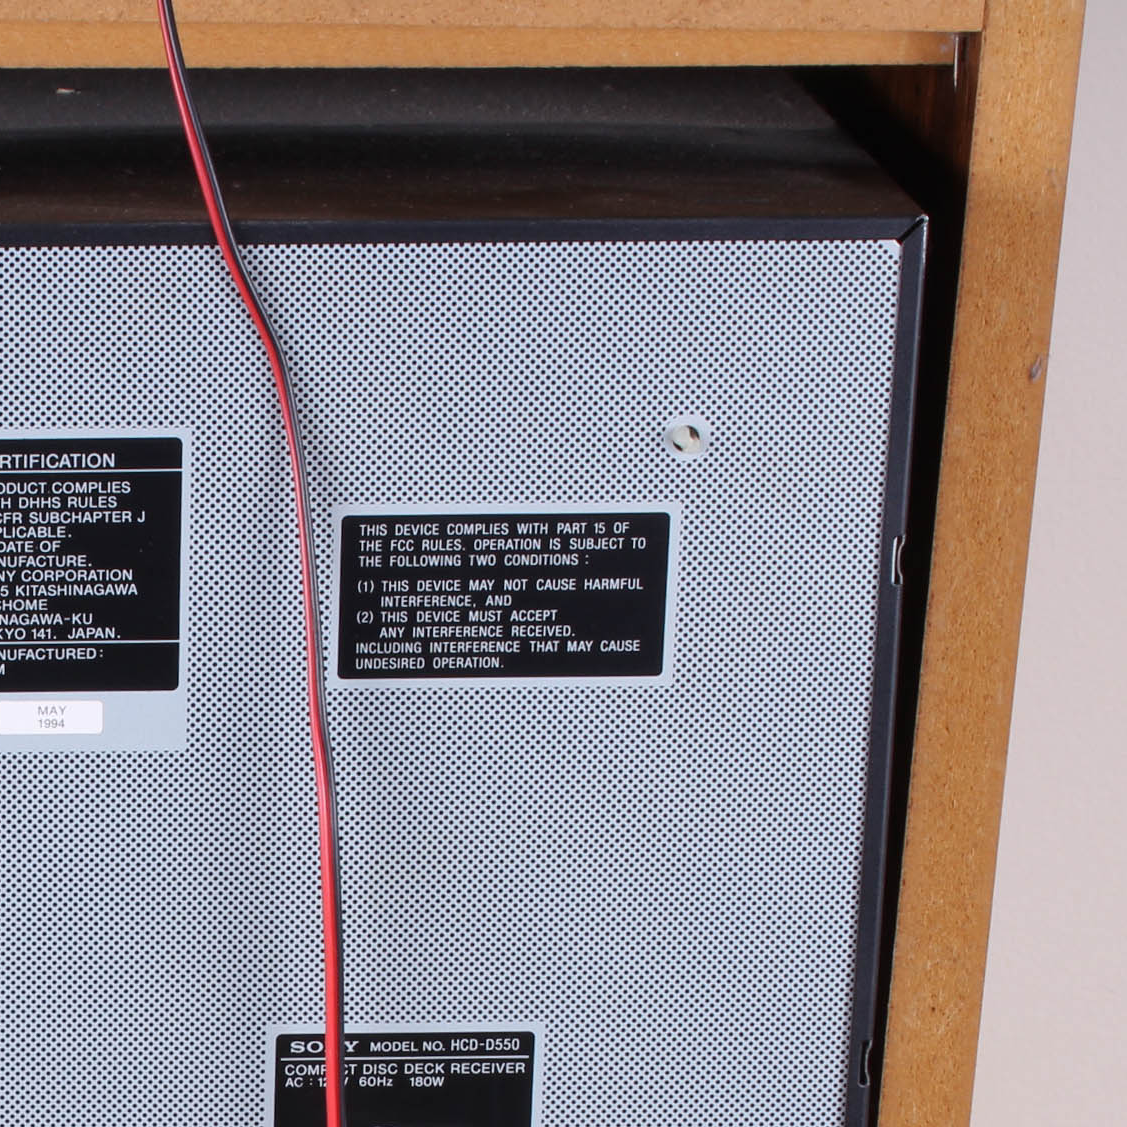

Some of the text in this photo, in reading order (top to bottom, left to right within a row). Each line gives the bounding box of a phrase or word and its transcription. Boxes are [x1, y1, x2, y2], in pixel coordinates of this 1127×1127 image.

[51, 481, 131, 494] COMPLIES
[18, 496, 61, 509] DHHS
[68, 496, 117, 508] RULES
[29, 511, 145, 524] SUBCHAPTER J
[360, 521, 630, 537] THIS DEVICE COMPLIES WITH PART 15 OF
[40, 541, 61, 553] OF
[360, 537, 646, 552] THE FCC RULES. OPERATION IS SUBJECT TO
[359, 556, 381, 568] THE
[389, 555, 461, 568] FOLLOWING
[469, 554, 496, 566] TWO
[21, 569, 132, 582] CORPORATION
[16, 584, 138, 597] KITASHINAGAWA
[358, 578, 643, 593] (1) THIS DEVICE MAY NOT CAUSE HARMFUL
[485, 595, 512, 607] AND
[356, 609, 558, 624] (2) THIS DEVICE MUST ACCEPT
[31, 628, 57, 640] 141.
[68, 627, 121, 639] JAPAN.
[380, 626, 405, 639] ANY
[412, 626, 503, 638] INTERFERENCE
[356, 639, 640, 655] INCLUDING INTERFERENCE THAT MAY CAUSE
[356, 656, 504, 670] UNDESIRED OPERATION.
[37, 705, 66, 716] MAY
[38, 719, 65, 729] 1994
[290, 1039, 520, 1053] SOY MODEL NO. HCD-D550
[363, 1063, 525, 1075] DISC DECK RECEIVER
[285, 1076, 444, 1088] AC 60Hz 180W
